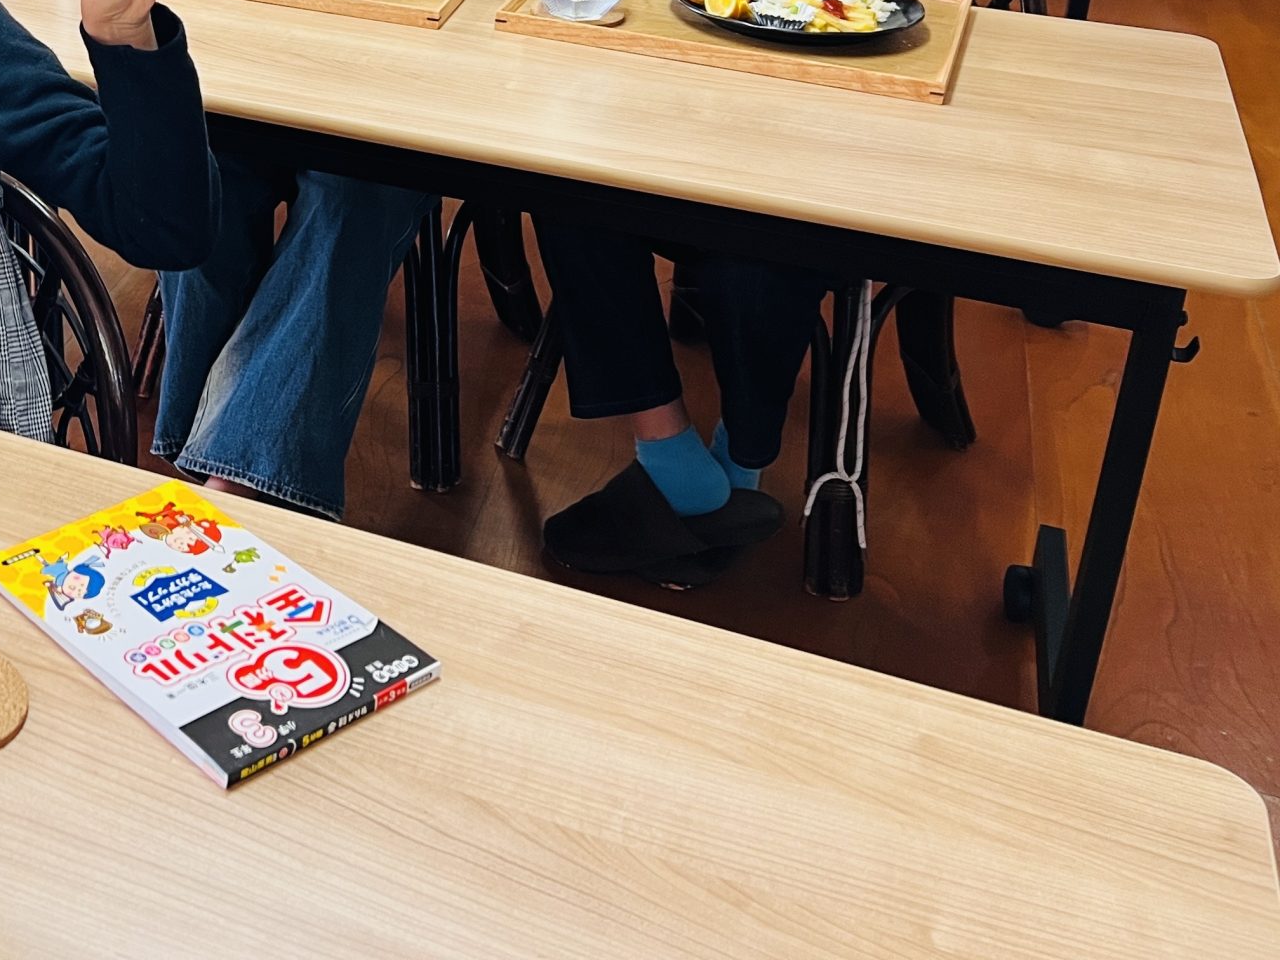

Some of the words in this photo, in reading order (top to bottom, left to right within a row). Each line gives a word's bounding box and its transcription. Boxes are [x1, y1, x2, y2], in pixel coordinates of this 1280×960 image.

[141, 589, 324, 681] 全科ドリル
